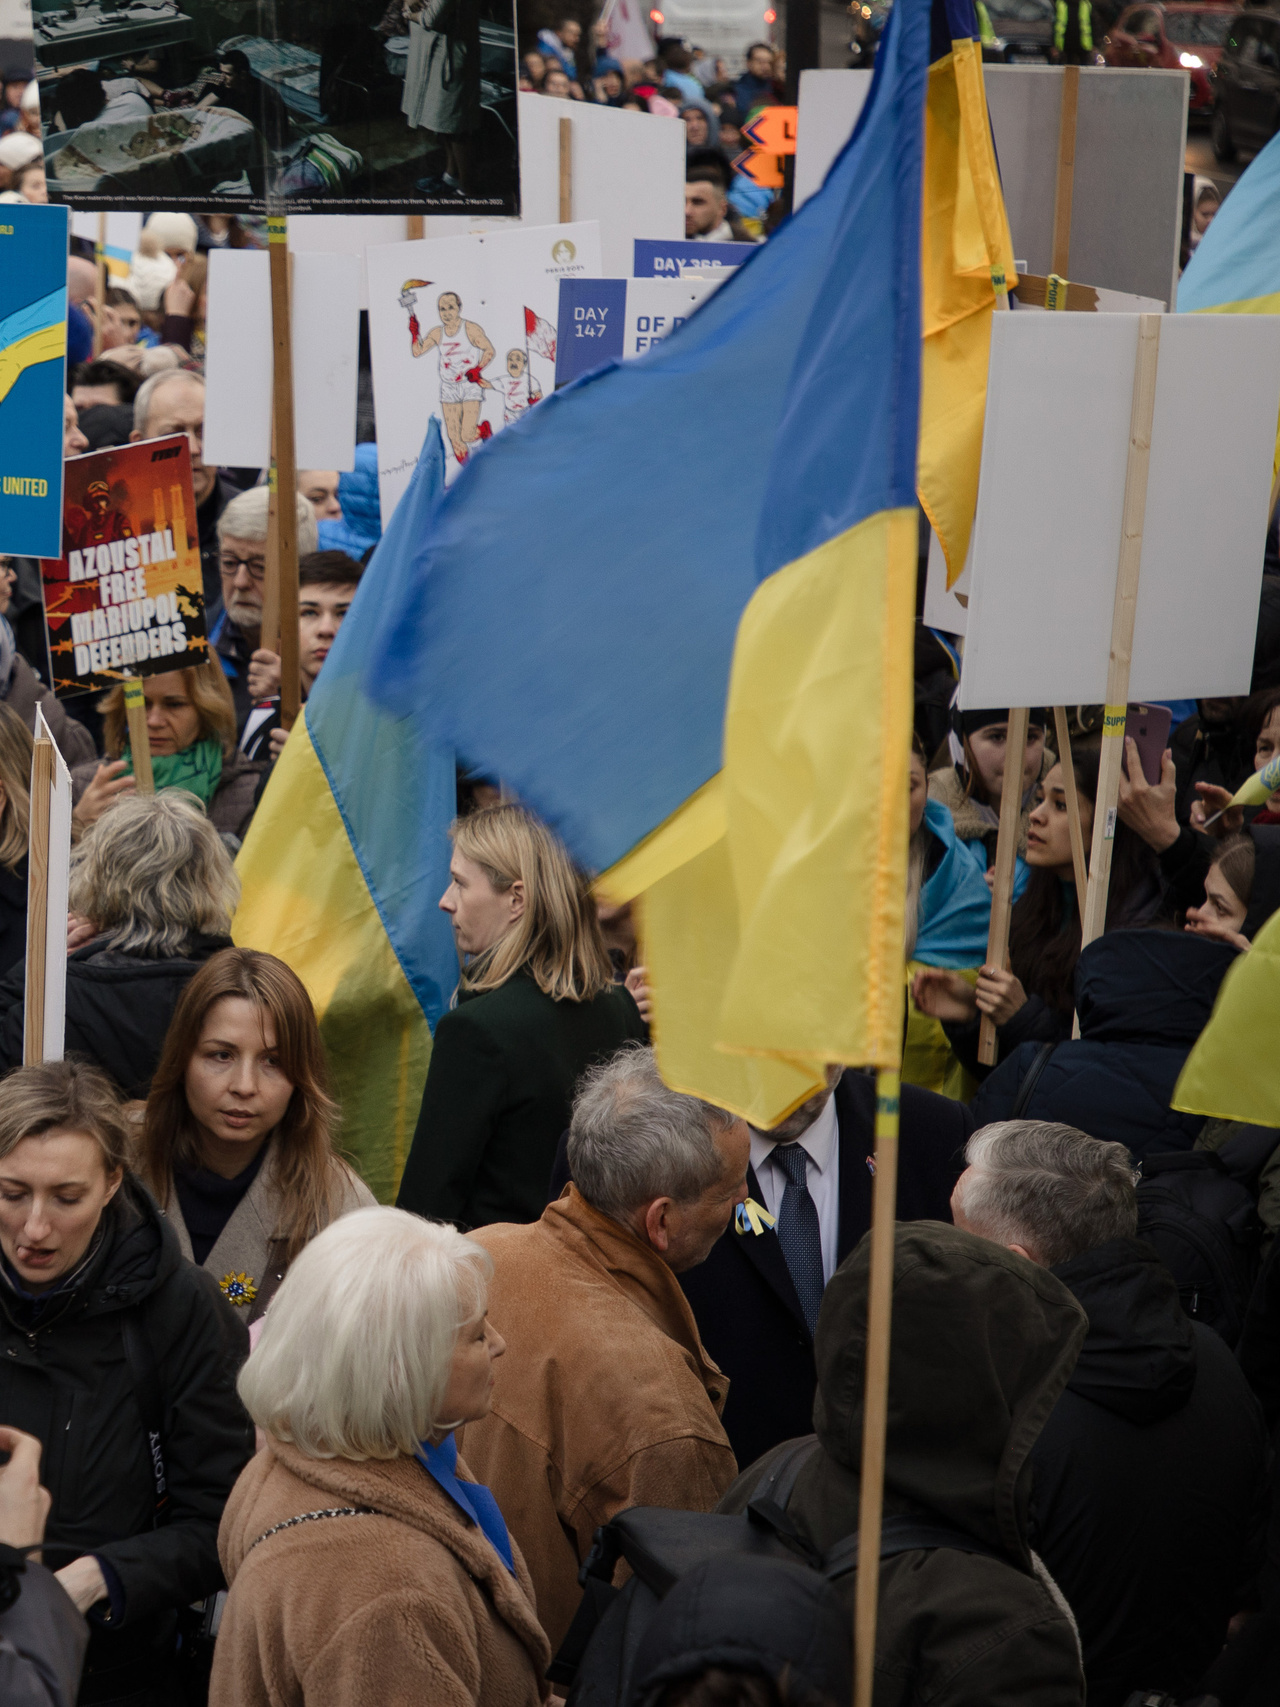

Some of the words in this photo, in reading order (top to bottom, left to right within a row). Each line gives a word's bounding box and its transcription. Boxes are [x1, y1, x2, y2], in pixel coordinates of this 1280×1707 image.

[653, 257, 687, 271] DAY
[574, 307, 609, 321] DAY
[636, 316, 666, 333] OF
[575, 324, 607, 338] 147
[3, 476, 48, 497] UNITED
[69, 529, 177, 582] AZOVSTAL
[98, 567, 147, 607] FREE
[70, 591, 182, 646] MARIUPOL
[73, 622, 188, 677] DEFENDERS
